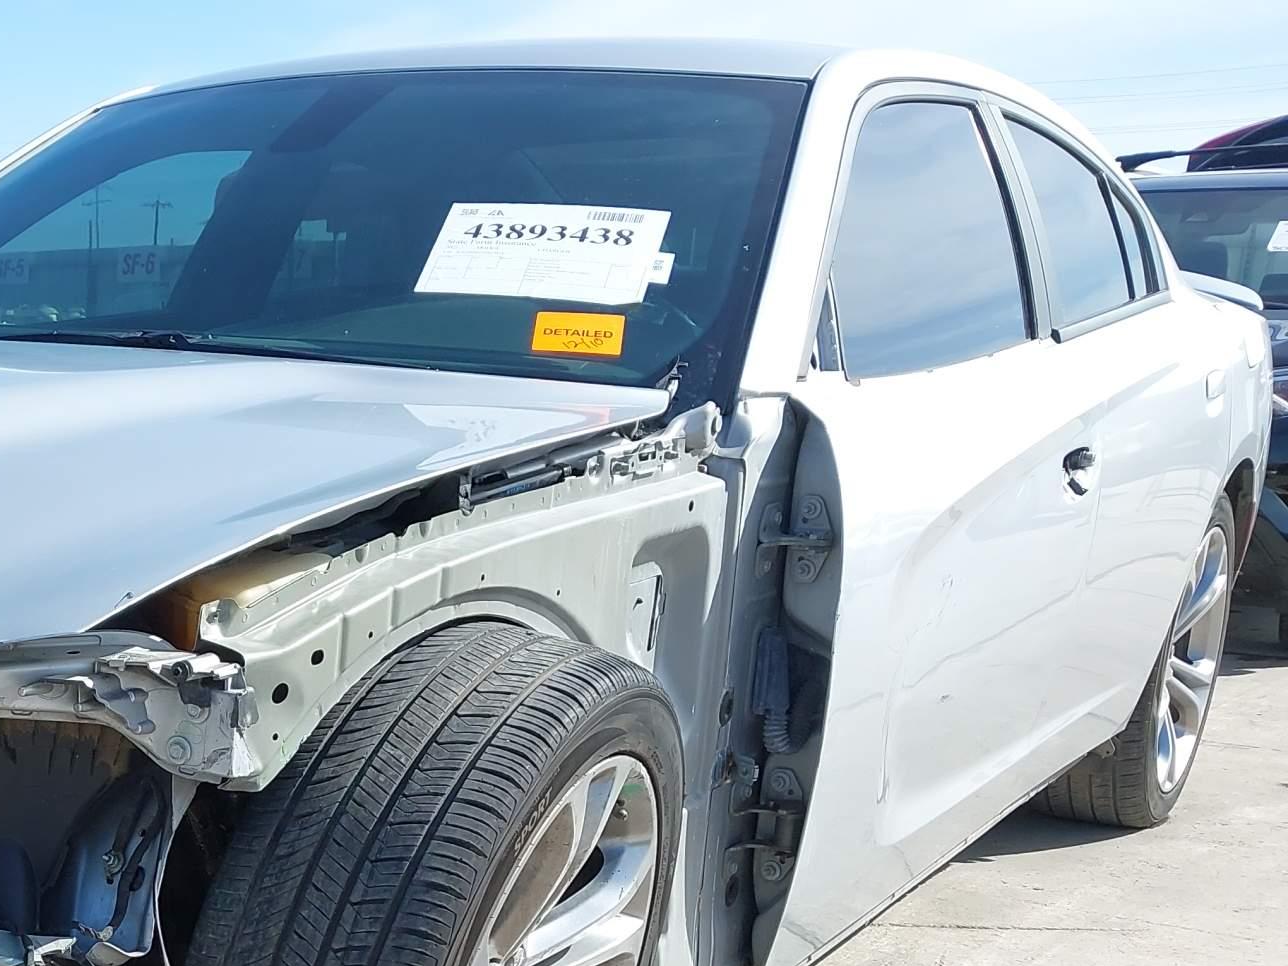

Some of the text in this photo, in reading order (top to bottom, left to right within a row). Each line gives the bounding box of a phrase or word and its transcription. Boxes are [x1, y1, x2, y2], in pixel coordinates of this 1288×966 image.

[463, 223, 635, 247] 43893438
[122, 253, 157, 275] SF-6
[543, 327, 614, 339] DETAILED
[514, 786, 553, 857] SPORT
